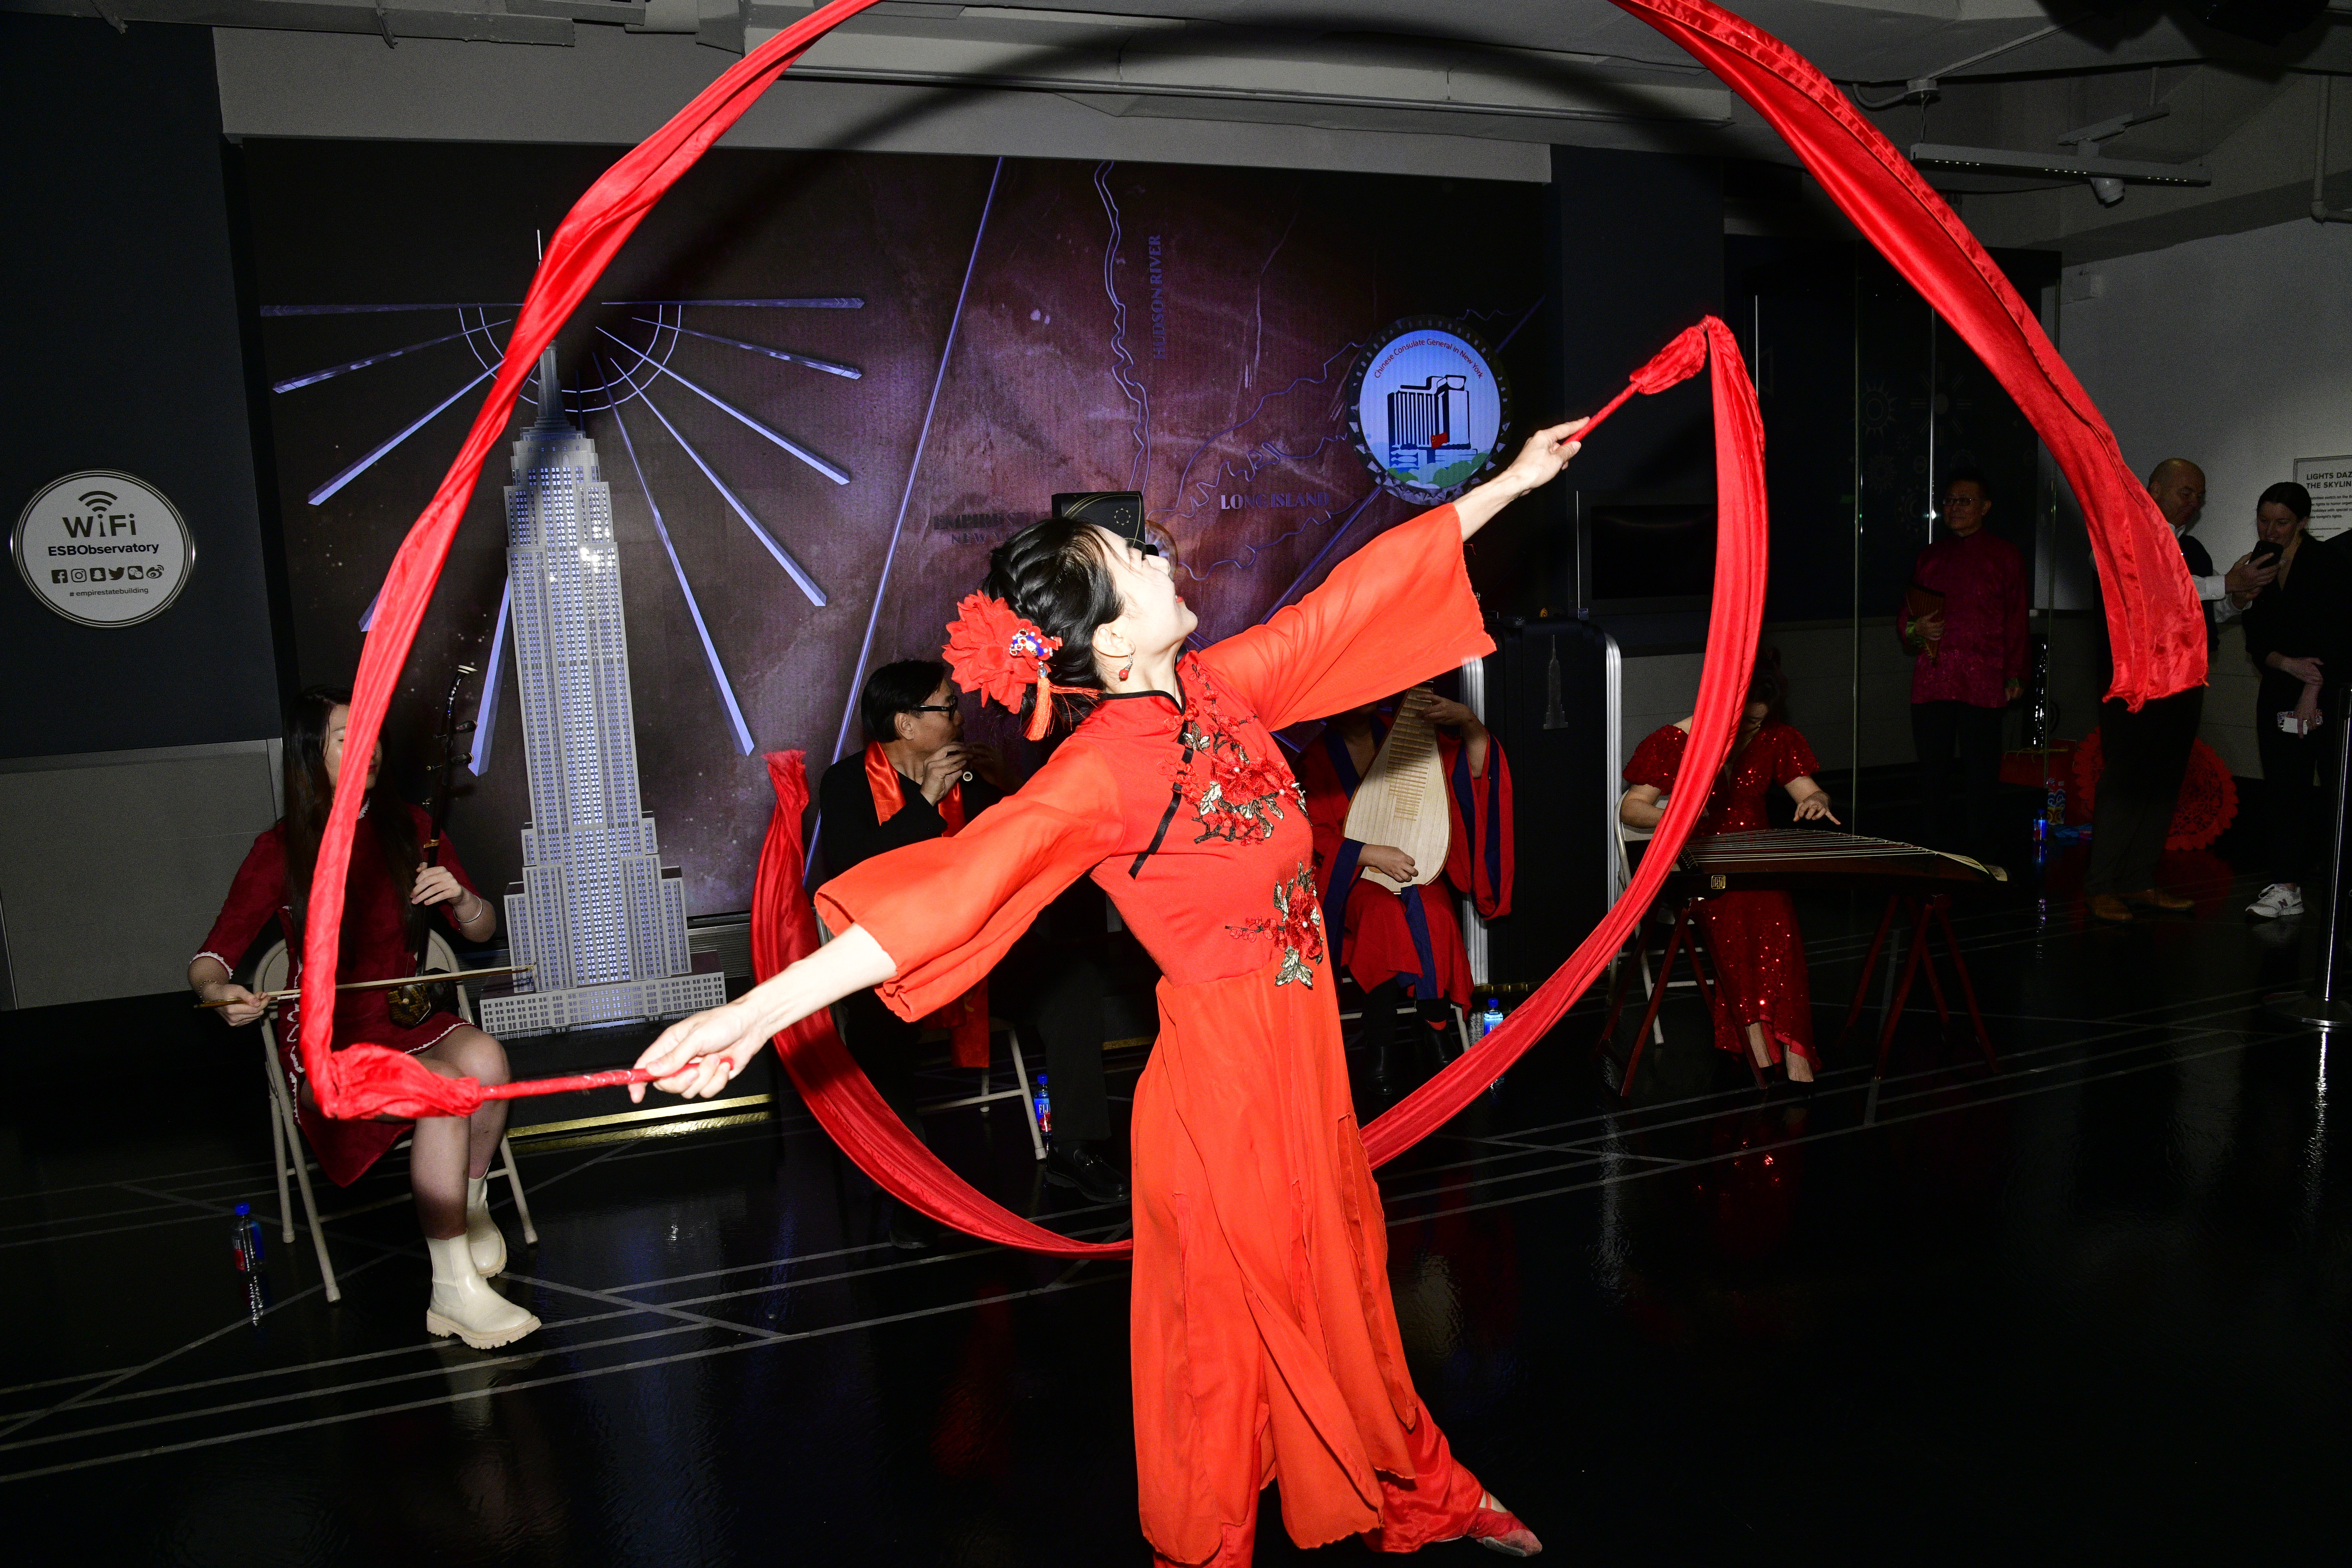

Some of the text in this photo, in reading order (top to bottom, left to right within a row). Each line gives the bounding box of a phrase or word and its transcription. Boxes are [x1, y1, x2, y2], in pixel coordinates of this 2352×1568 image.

[1149, 235, 1166, 359] HUDSON RIVER
[1374, 354, 1394, 378] Chinese
[1394, 340, 1425, 356] Consulate
[1427, 338, 1453, 350] General
[1460, 350, 1473, 364] New
[1473, 363, 1483, 379] York
[1221, 492, 1330, 509] LONG ISLAND
[62, 513, 136, 538] WiFi
[933, 513, 1004, 530] EMPIRE
[951, 531, 1013, 545] NEW YO
[48, 543, 159, 556] ESBObservatory
[76, 588, 149, 597] empirestatebuilding
